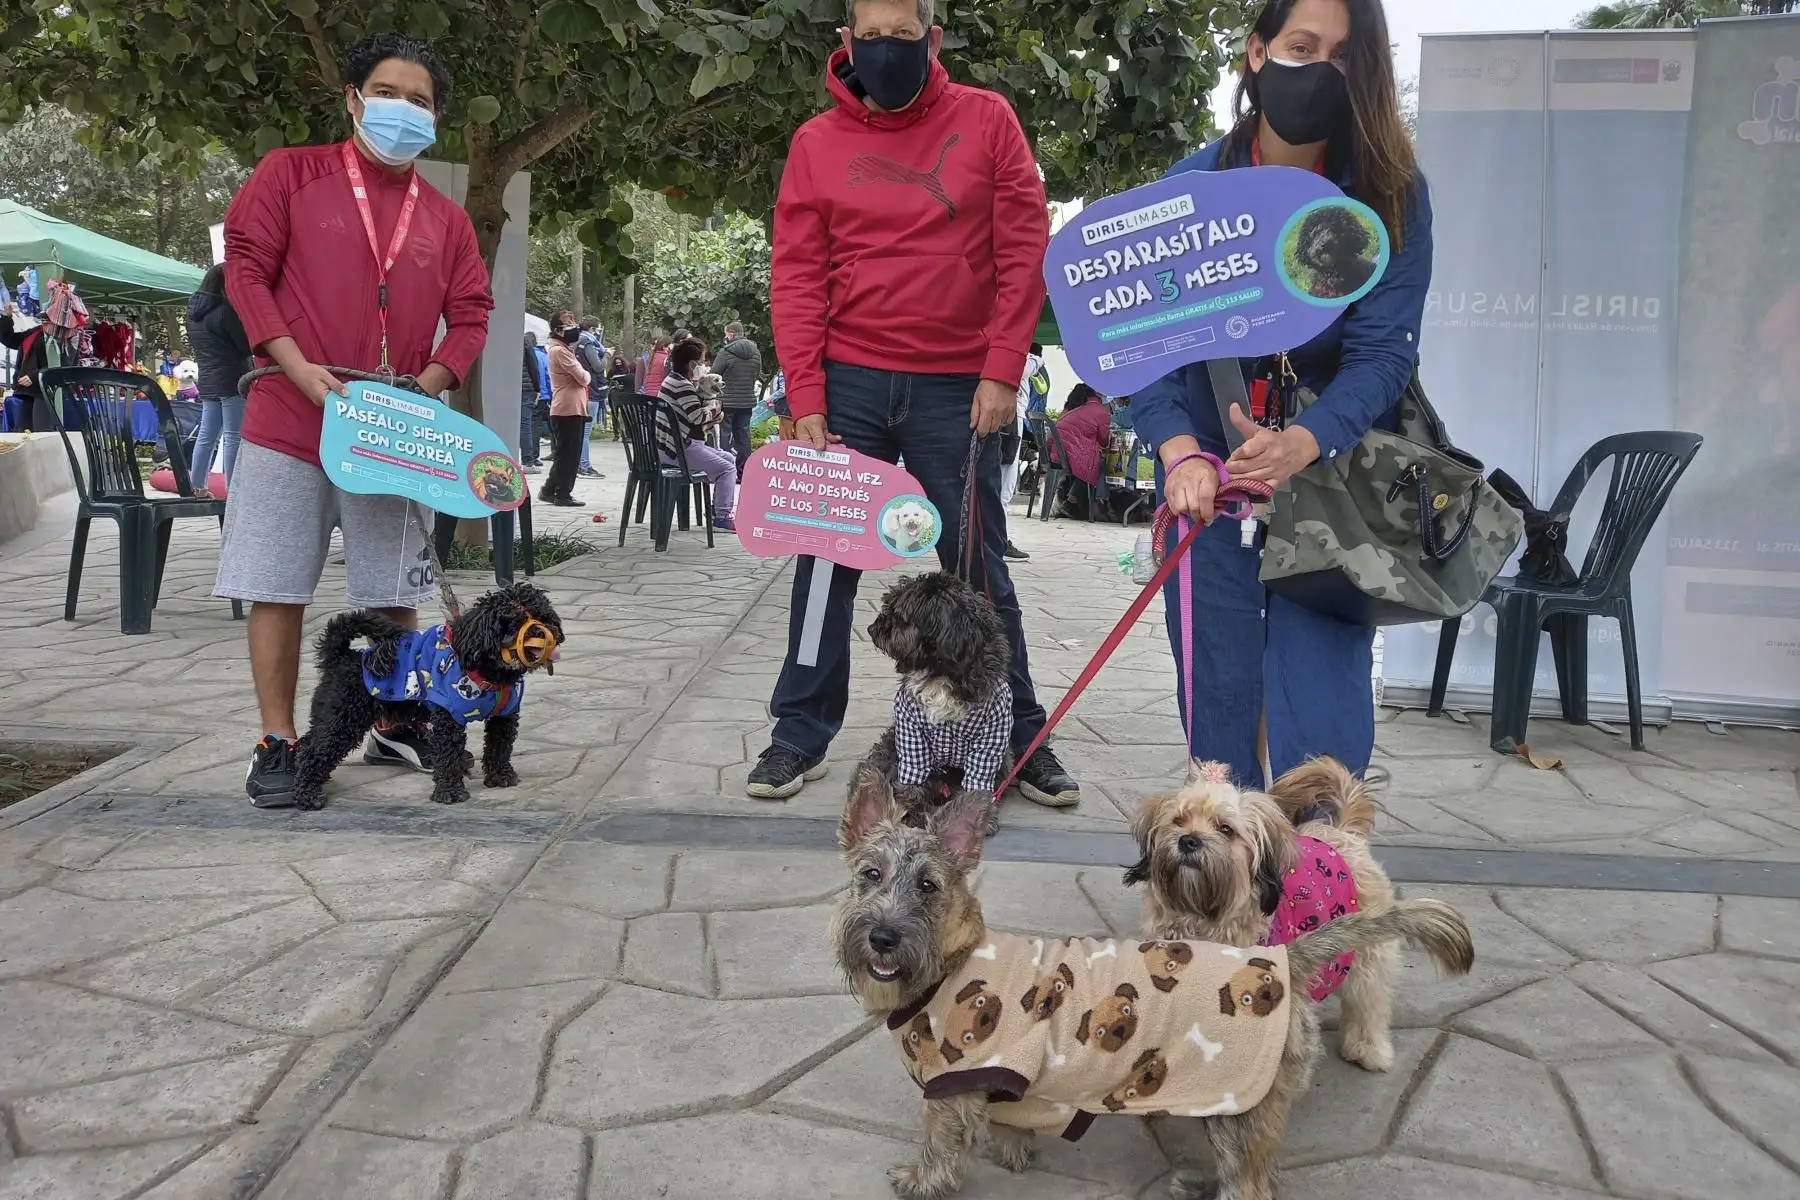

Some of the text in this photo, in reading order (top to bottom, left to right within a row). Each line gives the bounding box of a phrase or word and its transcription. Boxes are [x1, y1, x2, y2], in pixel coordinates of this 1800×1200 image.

[1087, 201, 1189, 240] DIRISLIMASUR
[1063, 213, 1255, 287] DESPARASÍTALO
[1088, 252, 1260, 316] CADA 3 MESES
[336, 400, 473, 452] PASÉALO SIEMPRE
[357, 429, 455, 466] CON CORREA
[762, 457, 883, 486] VACÚNALO UNA VEZ
[768, 476, 870, 503] AL AÑO DESPUÉS
[771, 494, 867, 521] DE LOS 3 MESES
